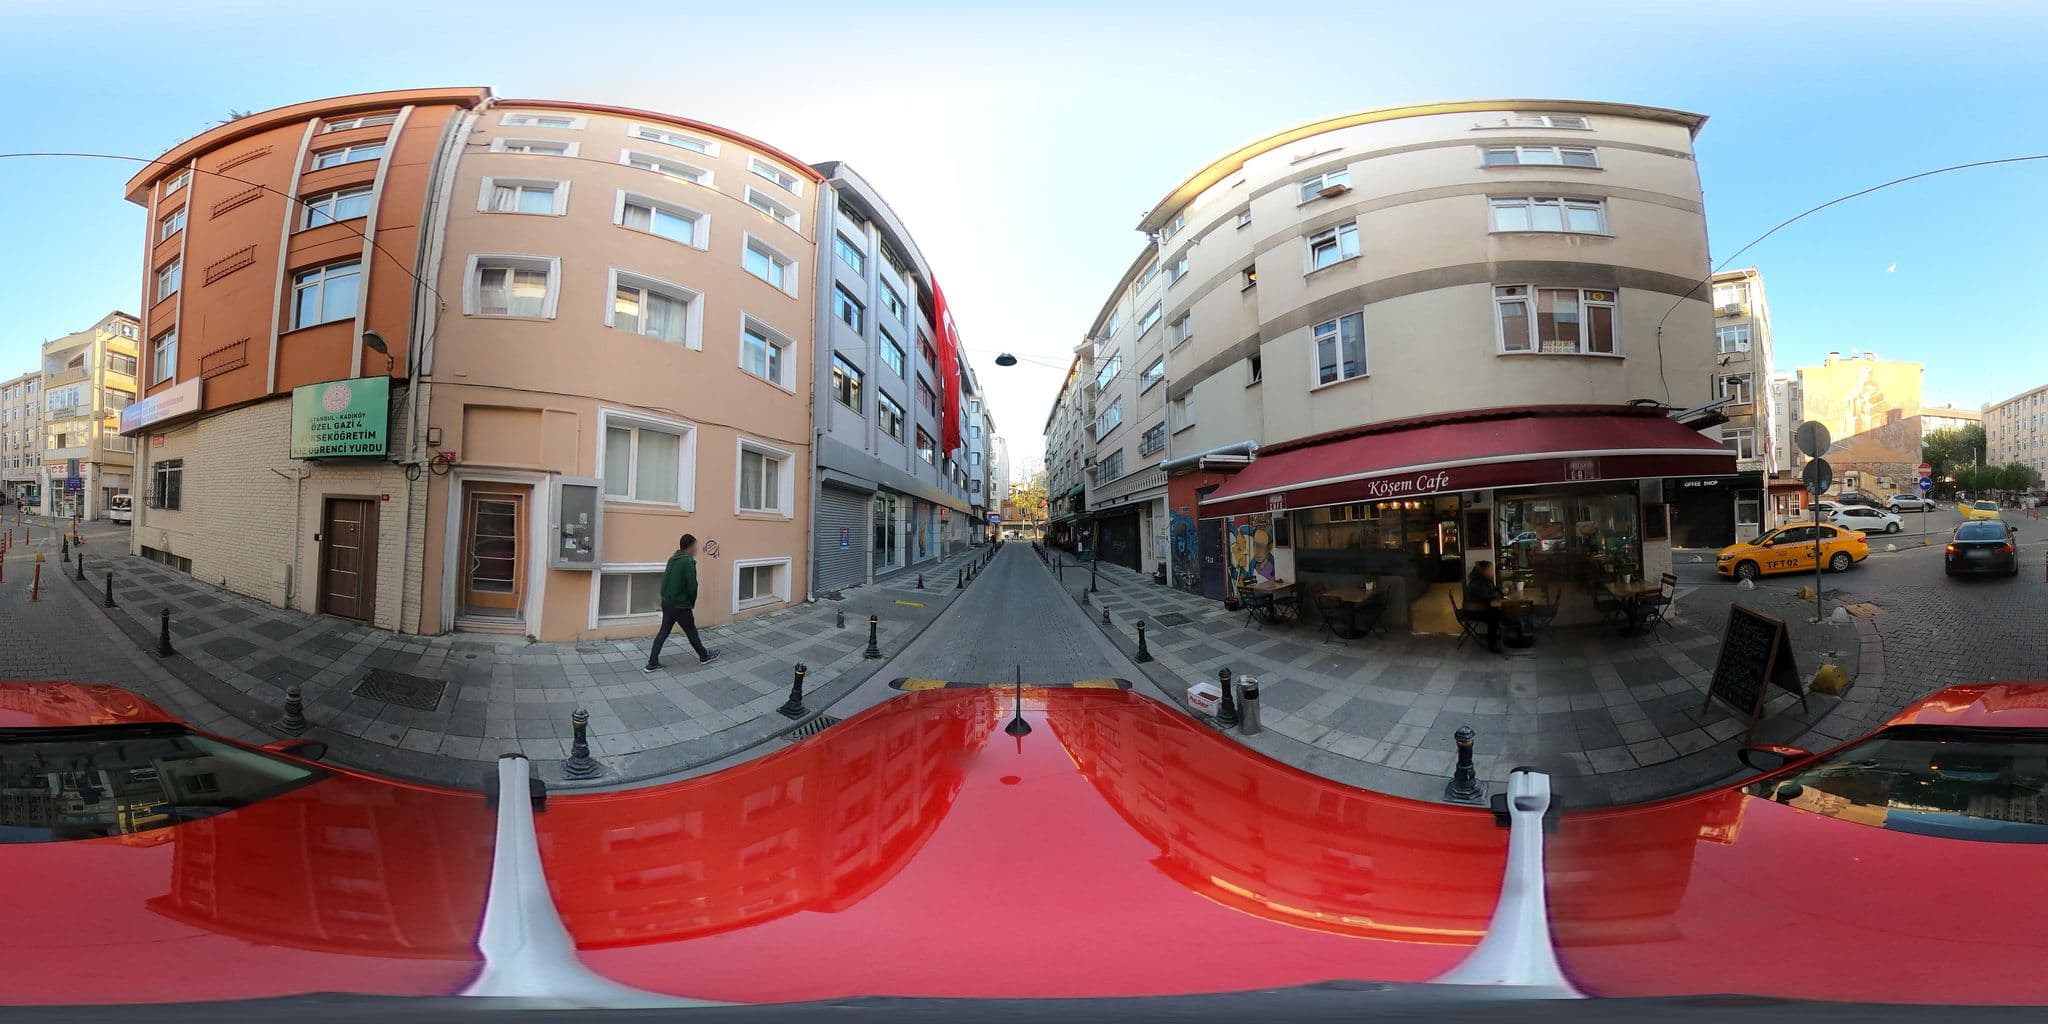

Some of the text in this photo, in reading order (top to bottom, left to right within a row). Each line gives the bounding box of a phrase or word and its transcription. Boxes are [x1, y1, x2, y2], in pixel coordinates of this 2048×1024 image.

[340, 412, 366, 420] KADIKÖY
[311, 422, 332, 431] ÖZEL
[334, 419, 355, 430] GAZİ
[349, 443, 383, 453] YURDU
[1368, 471, 1449, 496] Köşem Cafe
[1767, 559, 1798, 568] TFT 02
